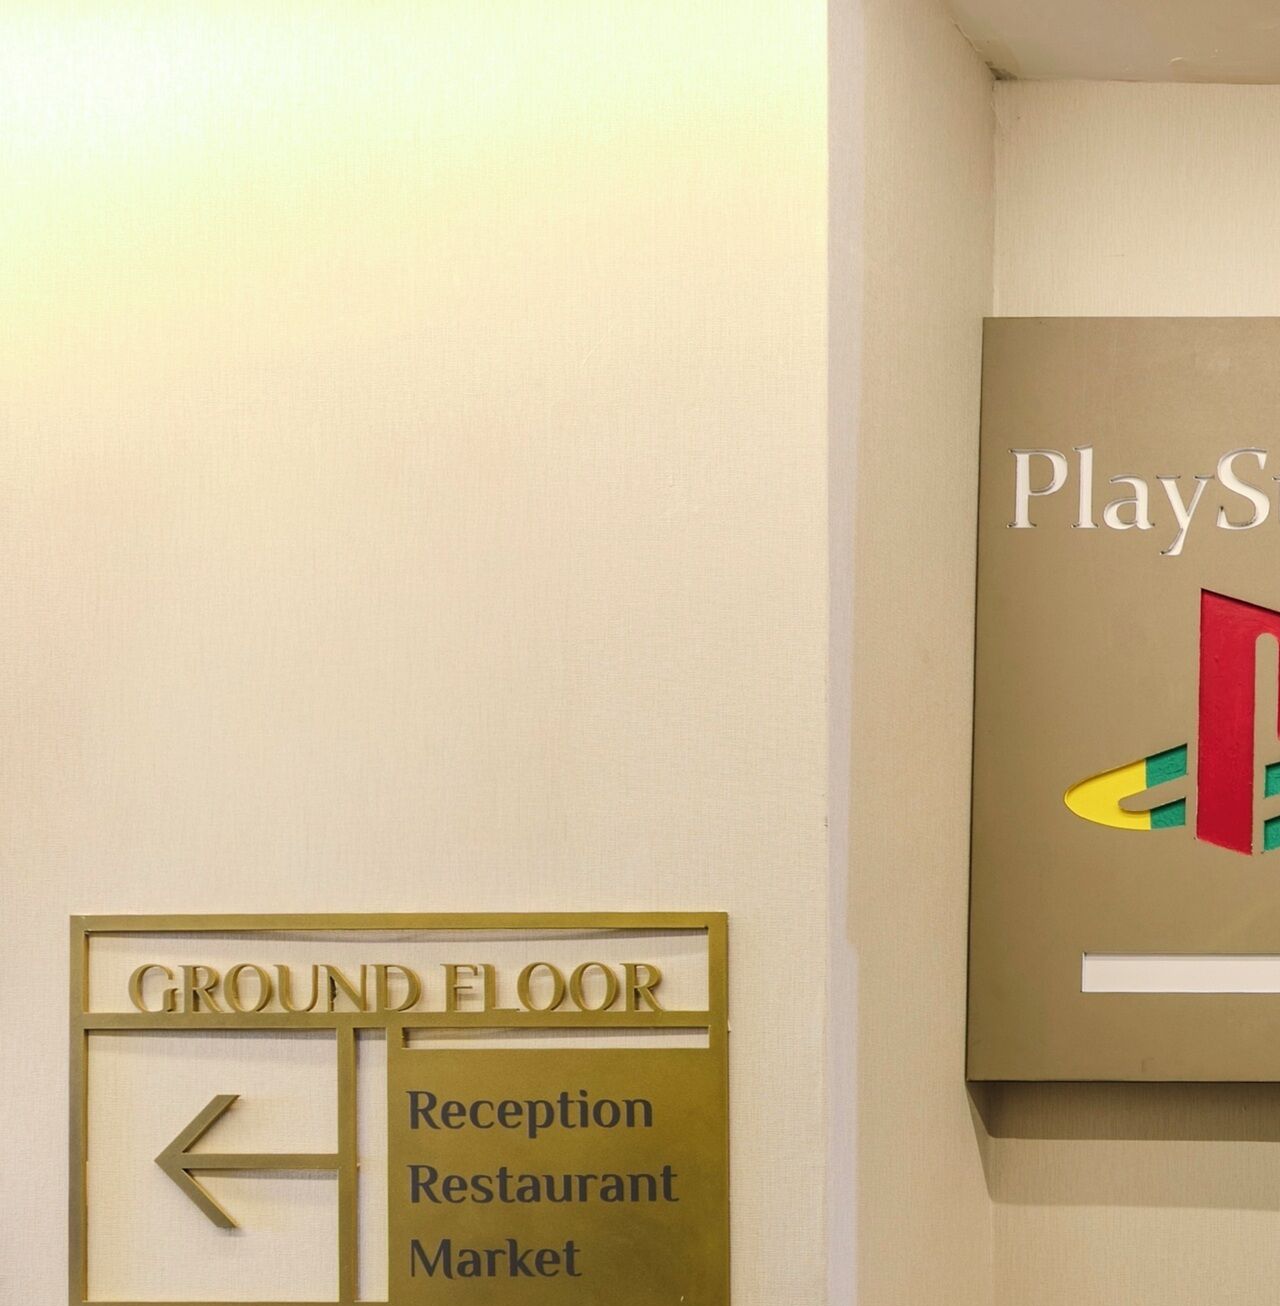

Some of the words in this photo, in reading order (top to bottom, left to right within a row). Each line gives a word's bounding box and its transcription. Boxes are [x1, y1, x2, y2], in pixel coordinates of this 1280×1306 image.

[127, 962, 423, 1014] GROUND
[440, 961, 665, 1014] FLOOR
[407, 1090, 655, 1138] Reception
[407, 1164, 680, 1204] Restaurant
[408, 1238, 582, 1280] Market
